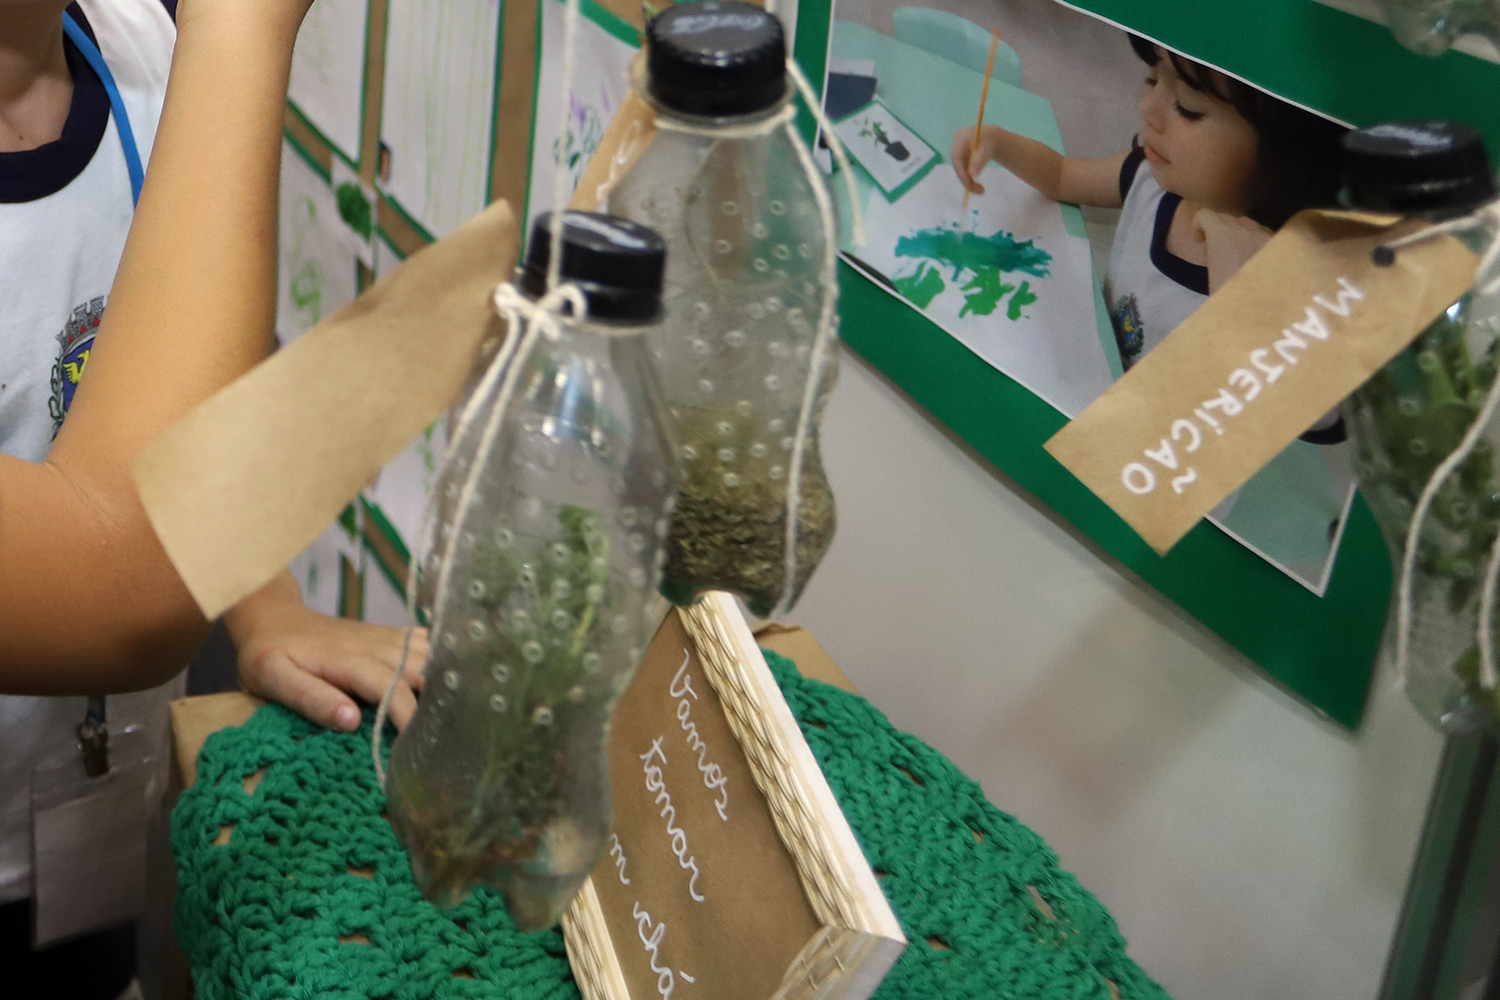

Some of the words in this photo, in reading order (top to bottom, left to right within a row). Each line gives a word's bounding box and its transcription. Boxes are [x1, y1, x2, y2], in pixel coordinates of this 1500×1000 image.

[1120, 276, 1367, 496] MANJERICÃO
[638, 735, 706, 903] tomar
[668, 647, 730, 822] Vamos
